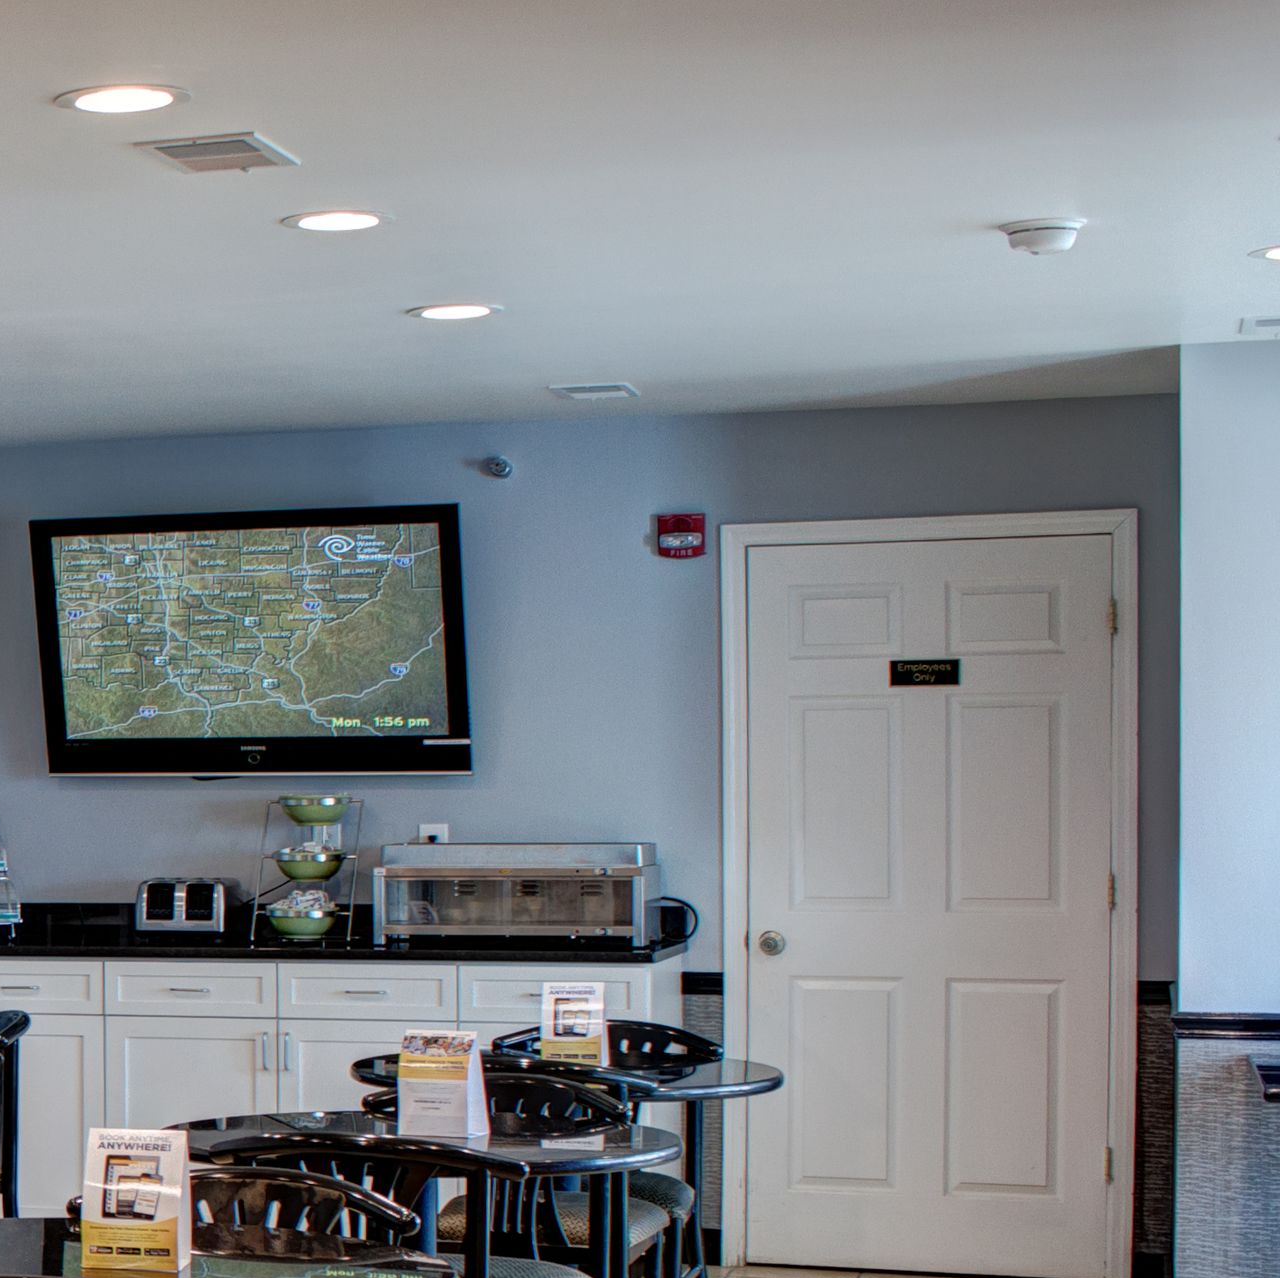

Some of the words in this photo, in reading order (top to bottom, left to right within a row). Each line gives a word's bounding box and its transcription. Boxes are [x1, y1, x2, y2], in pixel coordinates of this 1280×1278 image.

[670, 549, 694, 557] FIRE
[897, 663, 952, 673] Employees
[912, 673, 936, 683] Only
[332, 717, 361, 728] Mon
[374, 716, 404, 728] 1:56
[407, 717, 430, 729] pm
[97, 1142, 172, 1152] ANYWHERE!
